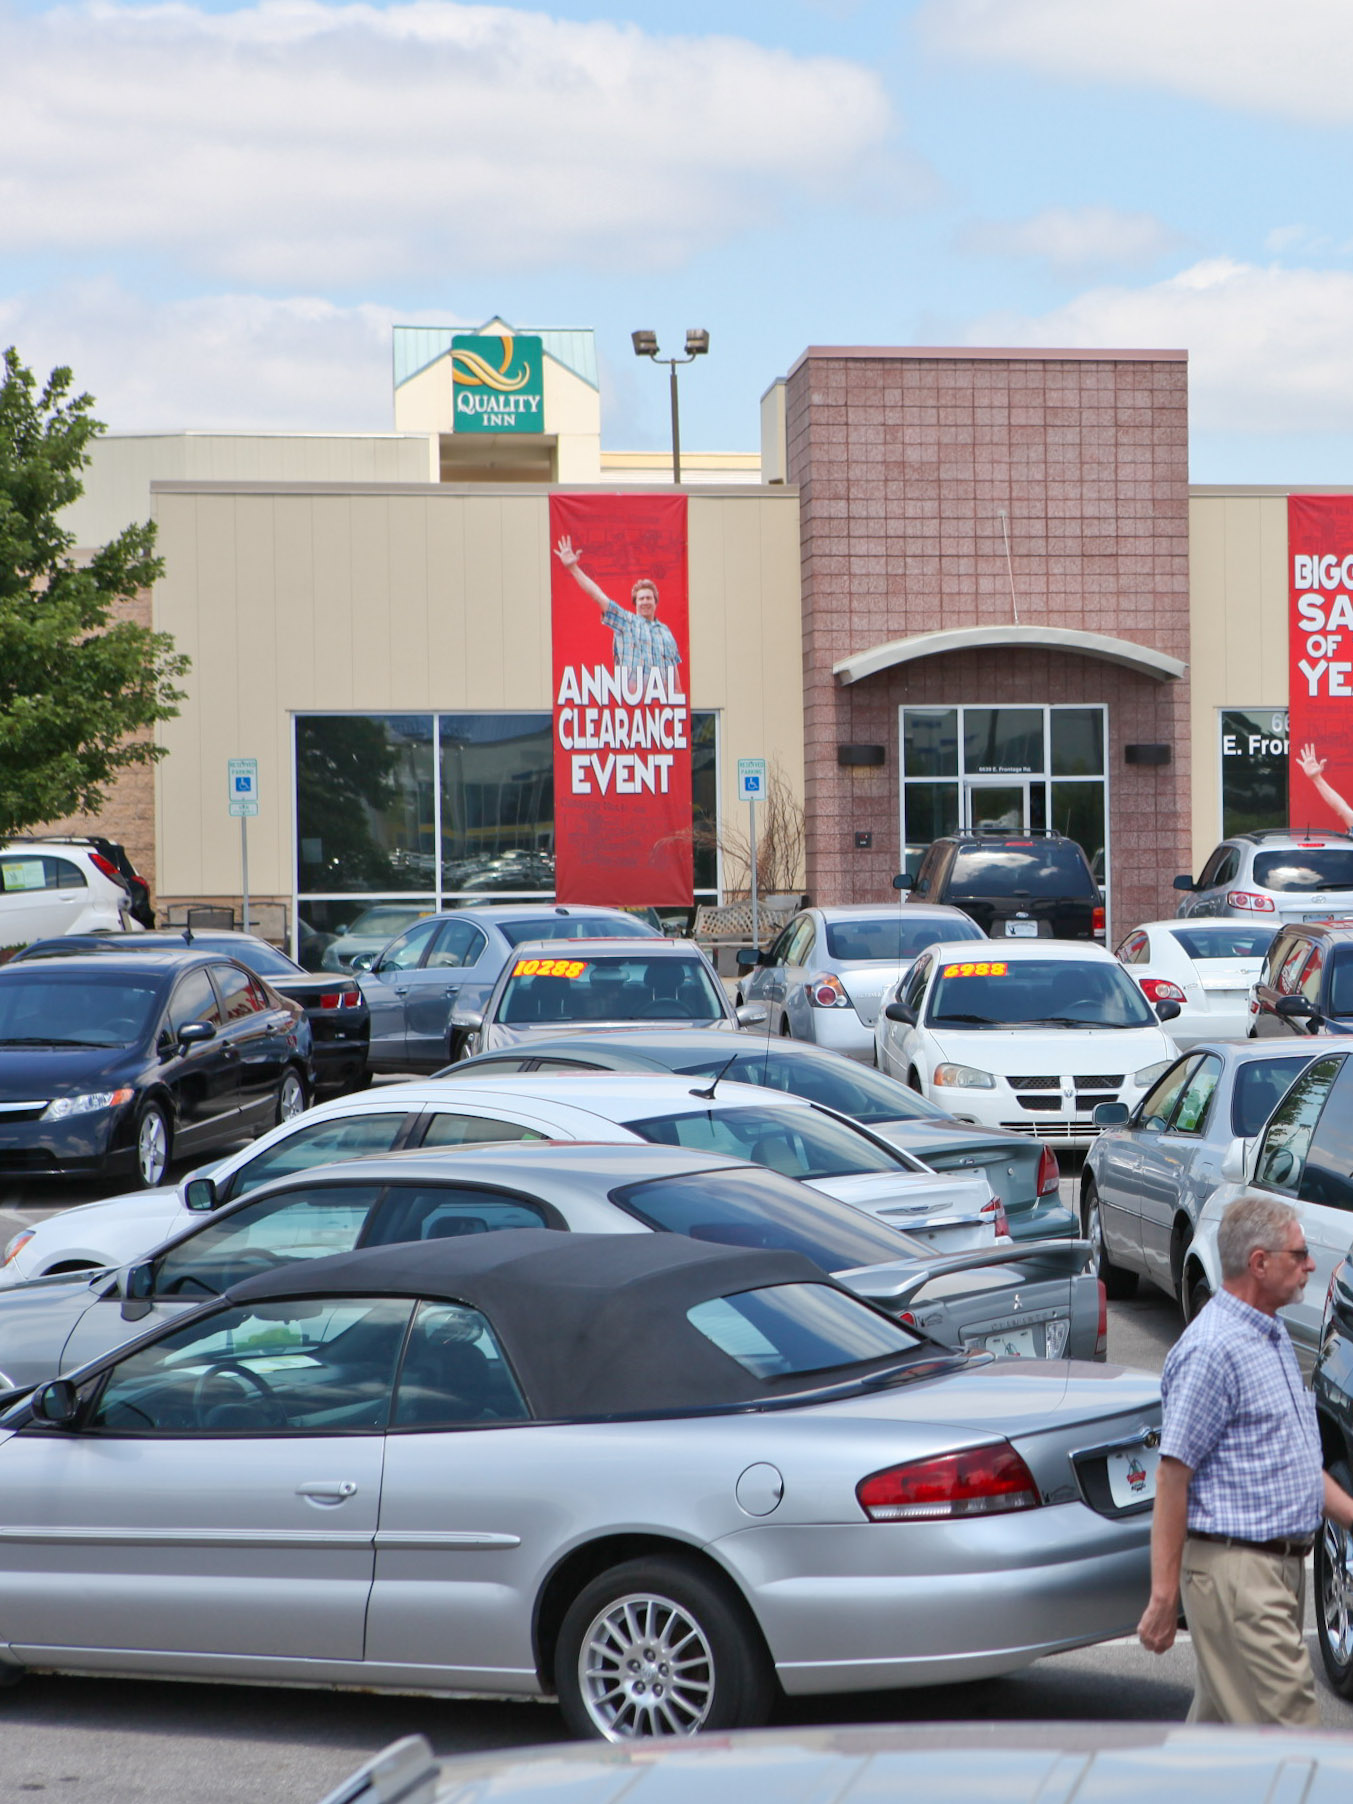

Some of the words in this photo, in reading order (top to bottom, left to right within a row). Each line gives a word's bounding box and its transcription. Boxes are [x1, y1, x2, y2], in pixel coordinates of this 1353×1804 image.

[457, 391, 540, 415] QUALITY
[482, 414, 516, 426] INN
[1306, 634, 1342, 658] OF
[557, 663, 686, 706] ANNUAL
[558, 707, 687, 750] CLEARANCE
[1223, 735, 1242, 755] E.
[571, 752, 675, 796] EVENT
[513, 960, 585, 978] 10288
[944, 963, 1006, 977] 6988
